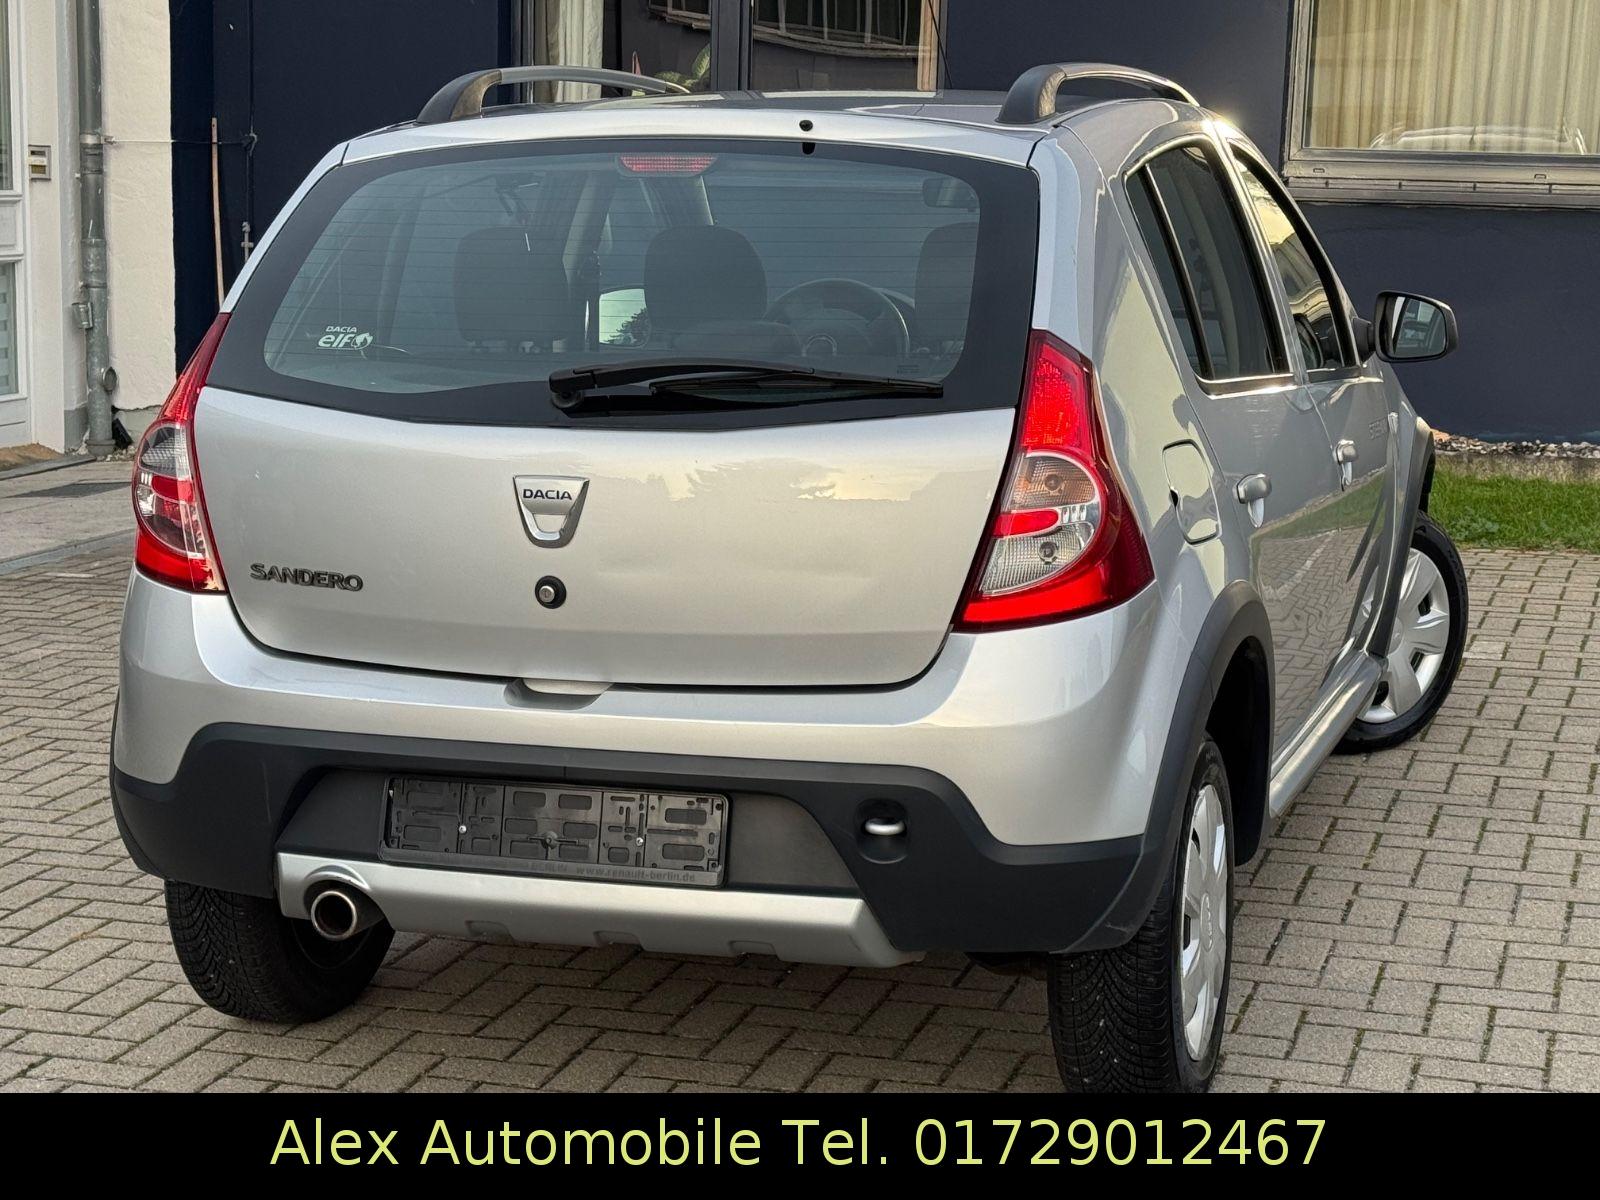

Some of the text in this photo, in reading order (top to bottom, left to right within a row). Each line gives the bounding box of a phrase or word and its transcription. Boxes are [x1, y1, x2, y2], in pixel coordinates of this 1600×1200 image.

[318, 333, 356, 348] elf
[523, 488, 573, 500] DACIA
[250, 563, 364, 592] SANDERO
[576, 864, 695, 883] www.renault-berlin.de
